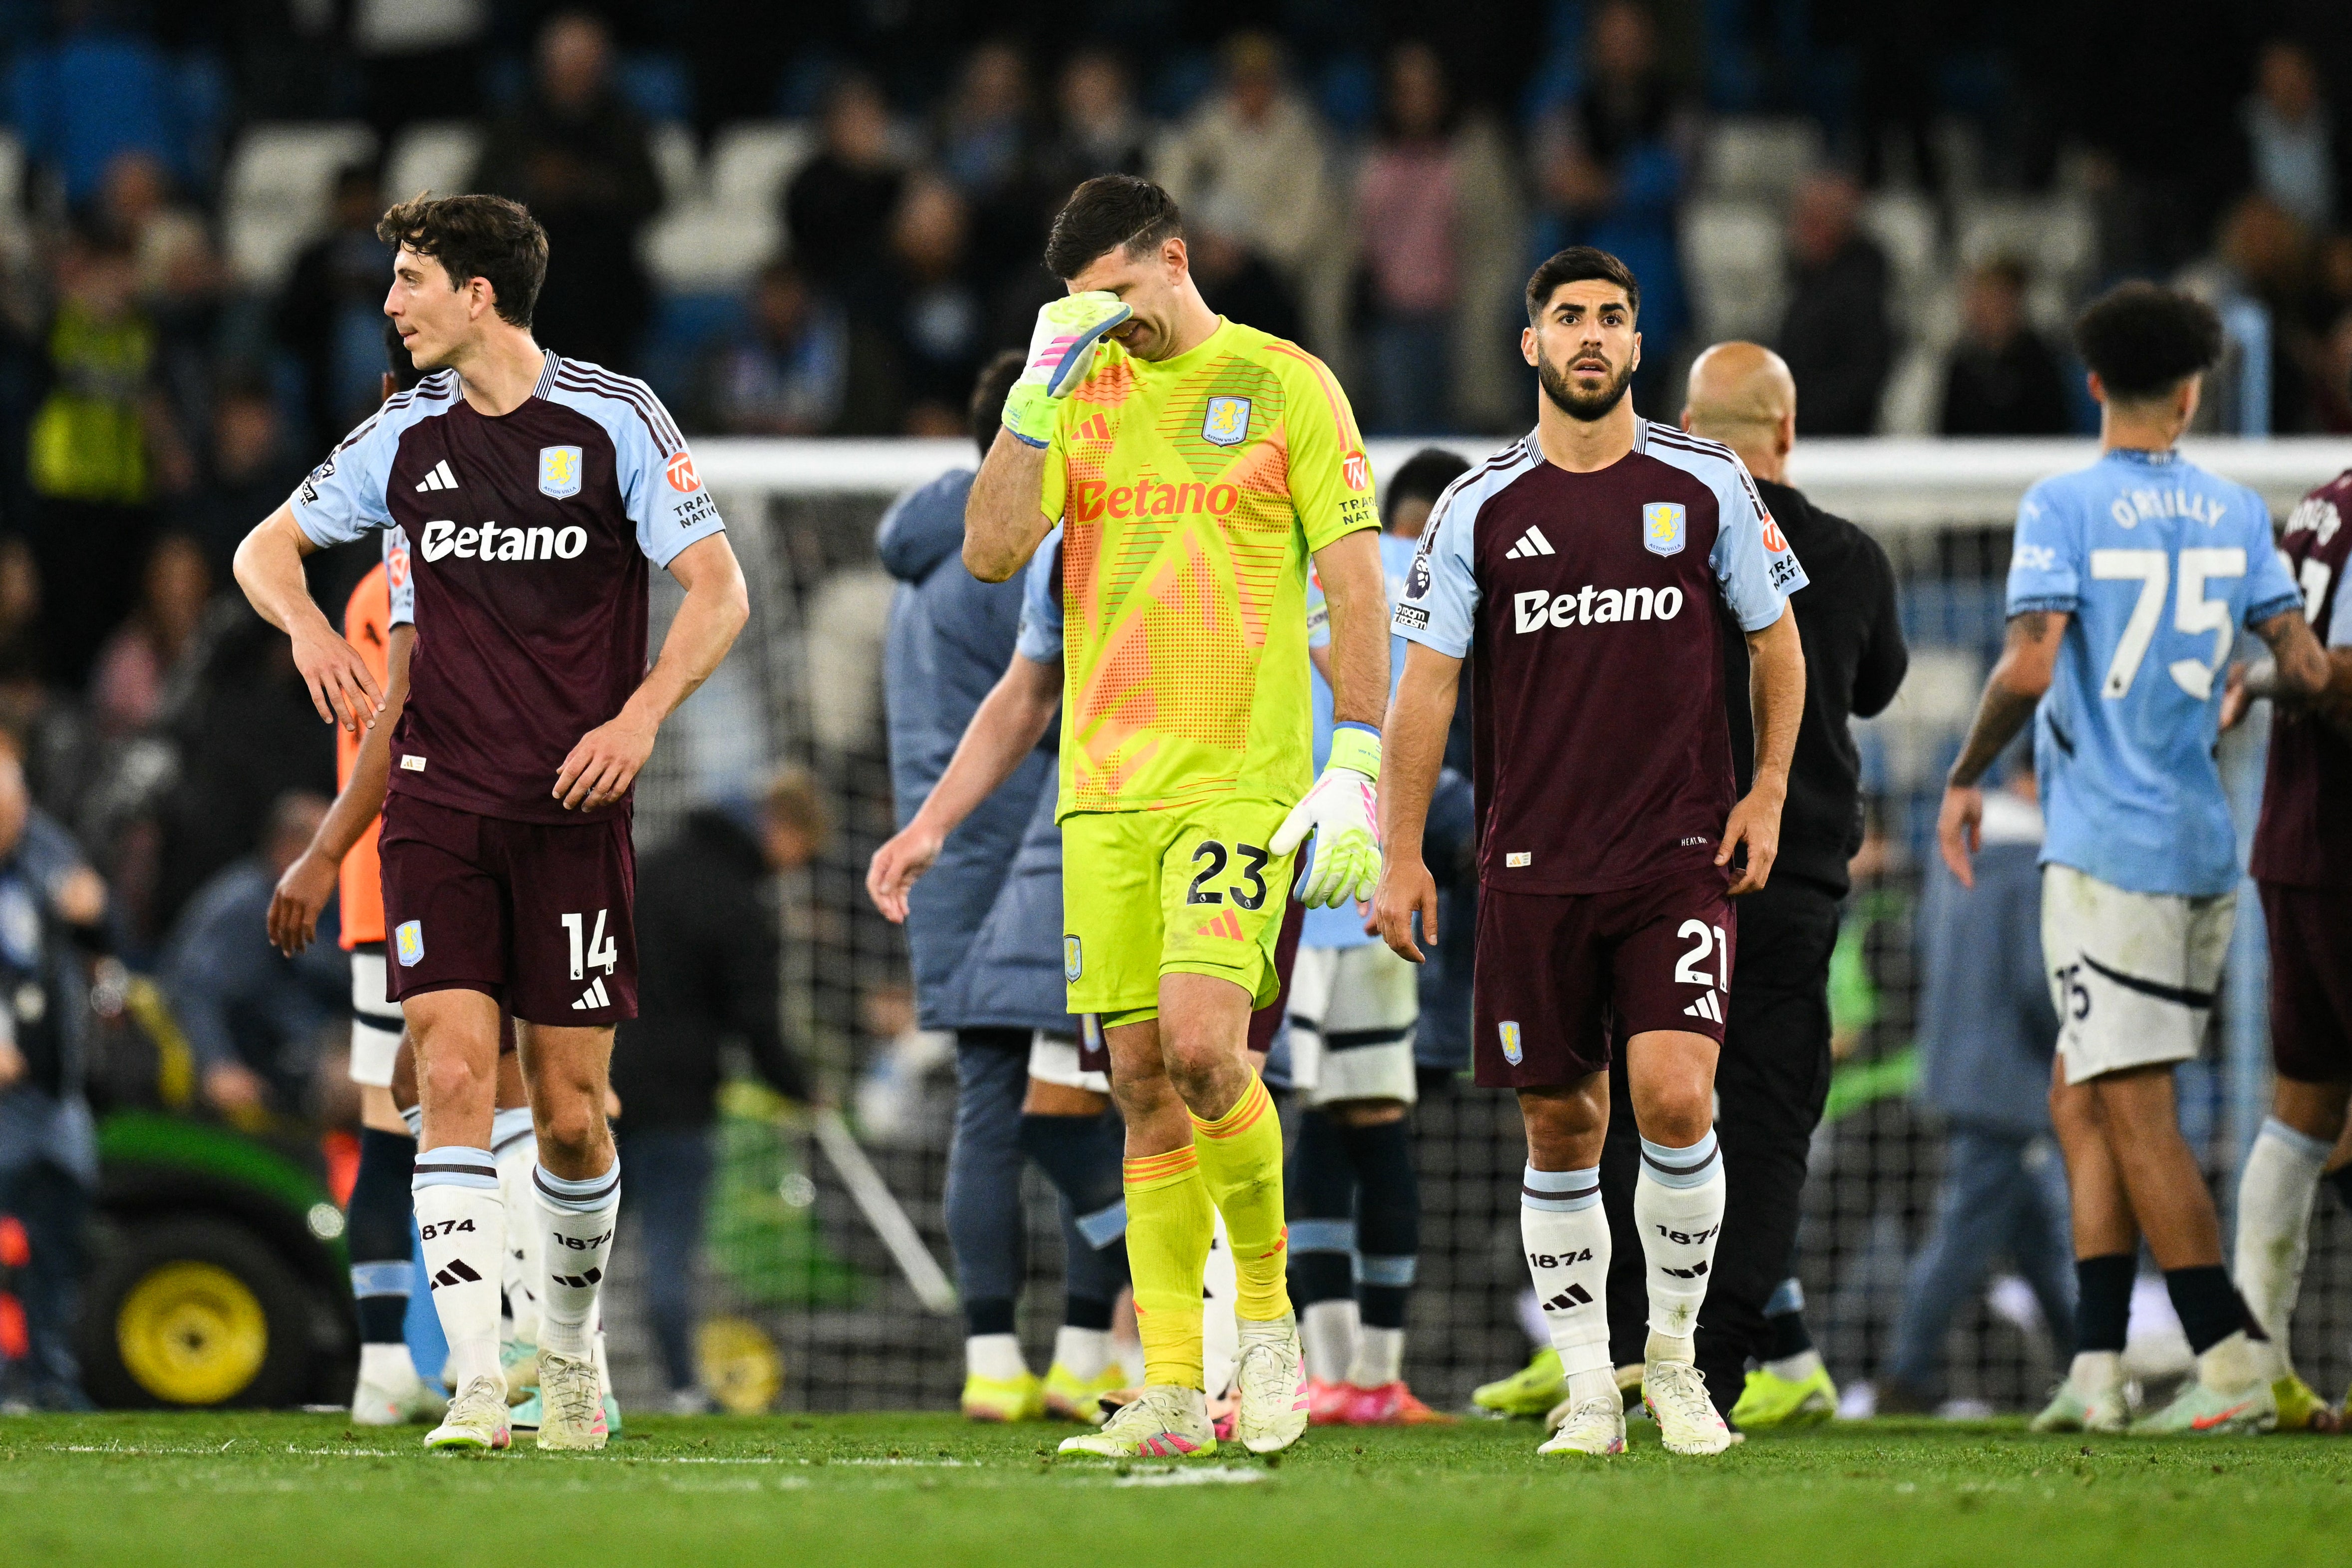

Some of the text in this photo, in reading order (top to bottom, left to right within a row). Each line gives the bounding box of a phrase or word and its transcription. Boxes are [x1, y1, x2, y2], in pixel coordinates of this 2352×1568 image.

[1077, 479, 1238, 523] Betano
[421, 521, 588, 562] Betano
[1649, 543, 1666, 551] ASTON
[1397, 614, 1427, 630] racism
[1401, 606, 1425, 621] room
[1514, 584, 1683, 634] Betano
[2090, 547, 2247, 700] 75
[1186, 840, 1269, 911] 23
[562, 908, 617, 980] 14
[1675, 919, 1728, 993] 21
[419, 1219, 476, 1242] 874
[1529, 1248, 1593, 1268] 1874
